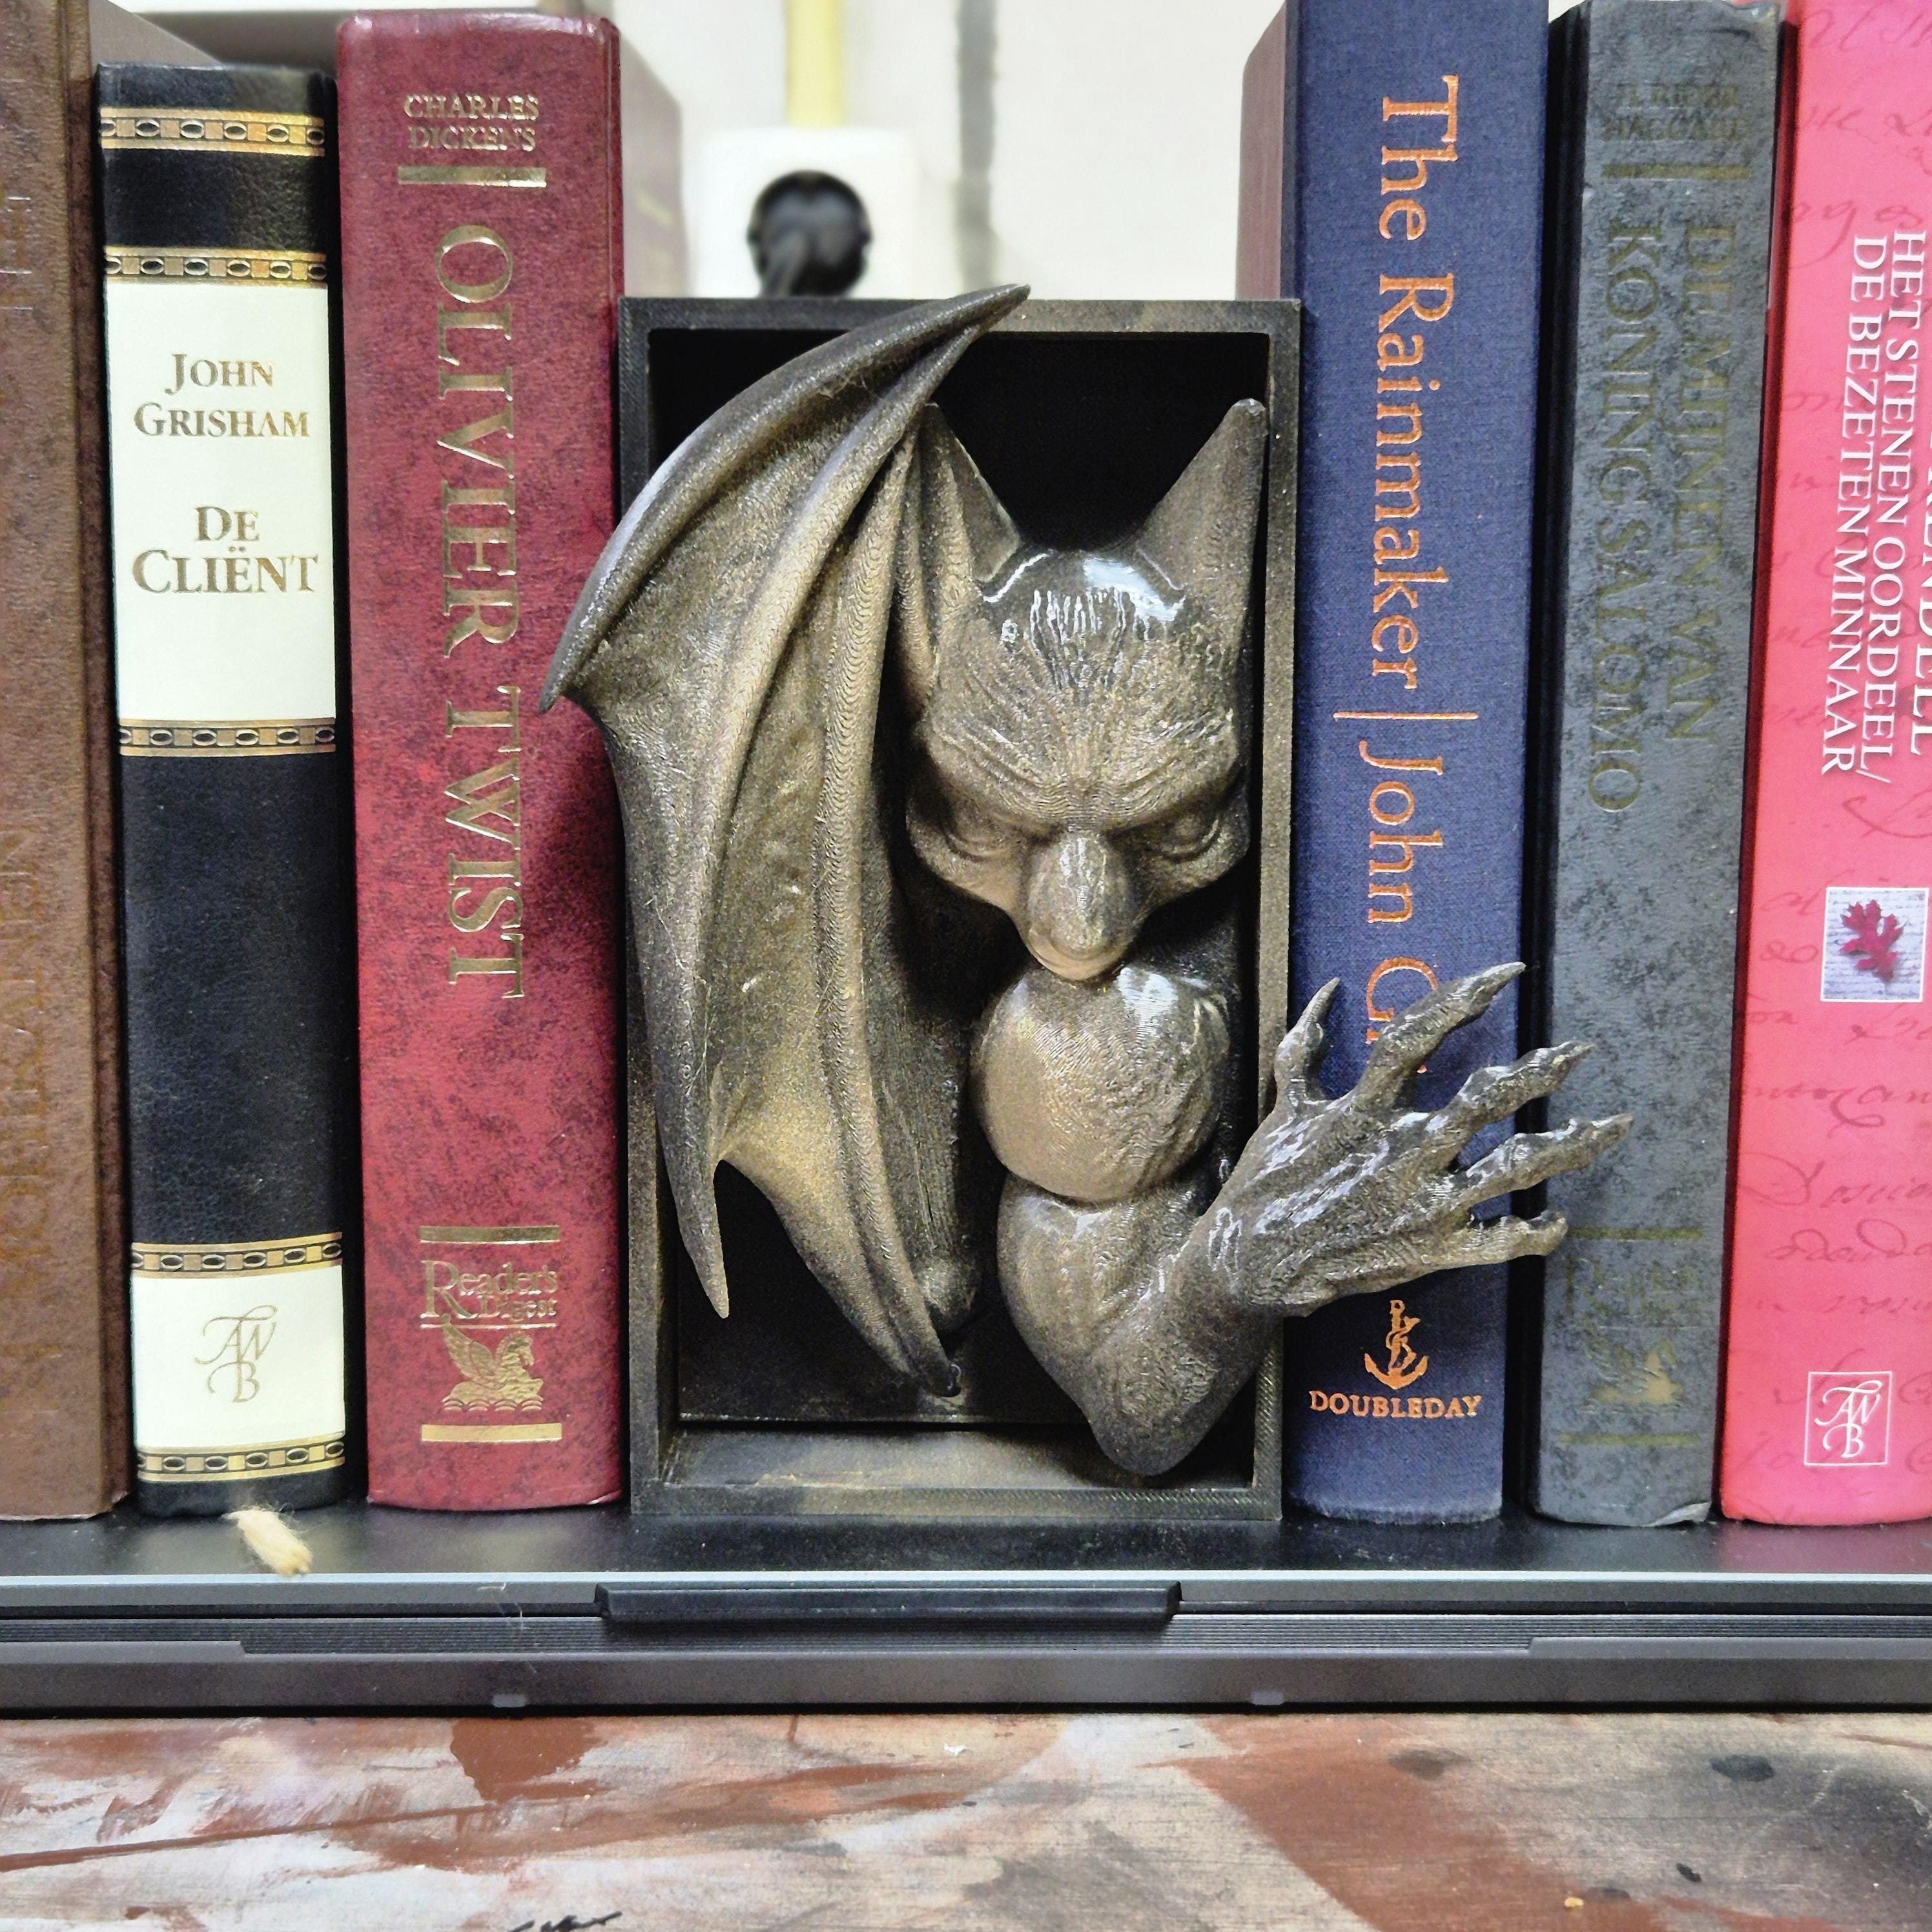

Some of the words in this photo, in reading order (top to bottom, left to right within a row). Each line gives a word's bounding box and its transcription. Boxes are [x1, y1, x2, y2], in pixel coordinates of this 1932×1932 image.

[404, 94, 540, 120] CHARLES
[407, 125, 536, 152] DICKENS
[1379, 74, 1459, 241] The
[1683, 220, 1736, 316] DE
[1851, 235, 1887, 303] DE
[1889, 229, 1927, 330] HET
[134, 402, 311, 438] GRISHAM
[165, 353, 274, 395] JOHN
[1600, 219, 1663, 505] KONING
[1837, 313, 1884, 537] BEZETEN
[435, 223, 519, 657] OLIVIER
[1371, 272, 1454, 690] Rainmaker
[1660, 334, 1731, 592] MIJNEN
[1877, 338, 1919, 527] STENEN
[132, 546, 319, 594] CLIËNT
[194, 505, 260, 542] DE
[1588, 519, 1652, 813] SALOMO
[1666, 606, 1722, 745] VAN
[1821, 546, 1868, 776] MINNAAR
[1856, 537, 1906, 783] OORDEEL/
[444, 685, 525, 998] TWIST
[1359, 739, 1444, 923] John
[420, 1260, 559, 1319] Reader's
[478, 1294, 558, 1322] Digest
[1310, 1390, 1483, 1419] DOUBLEDAY
